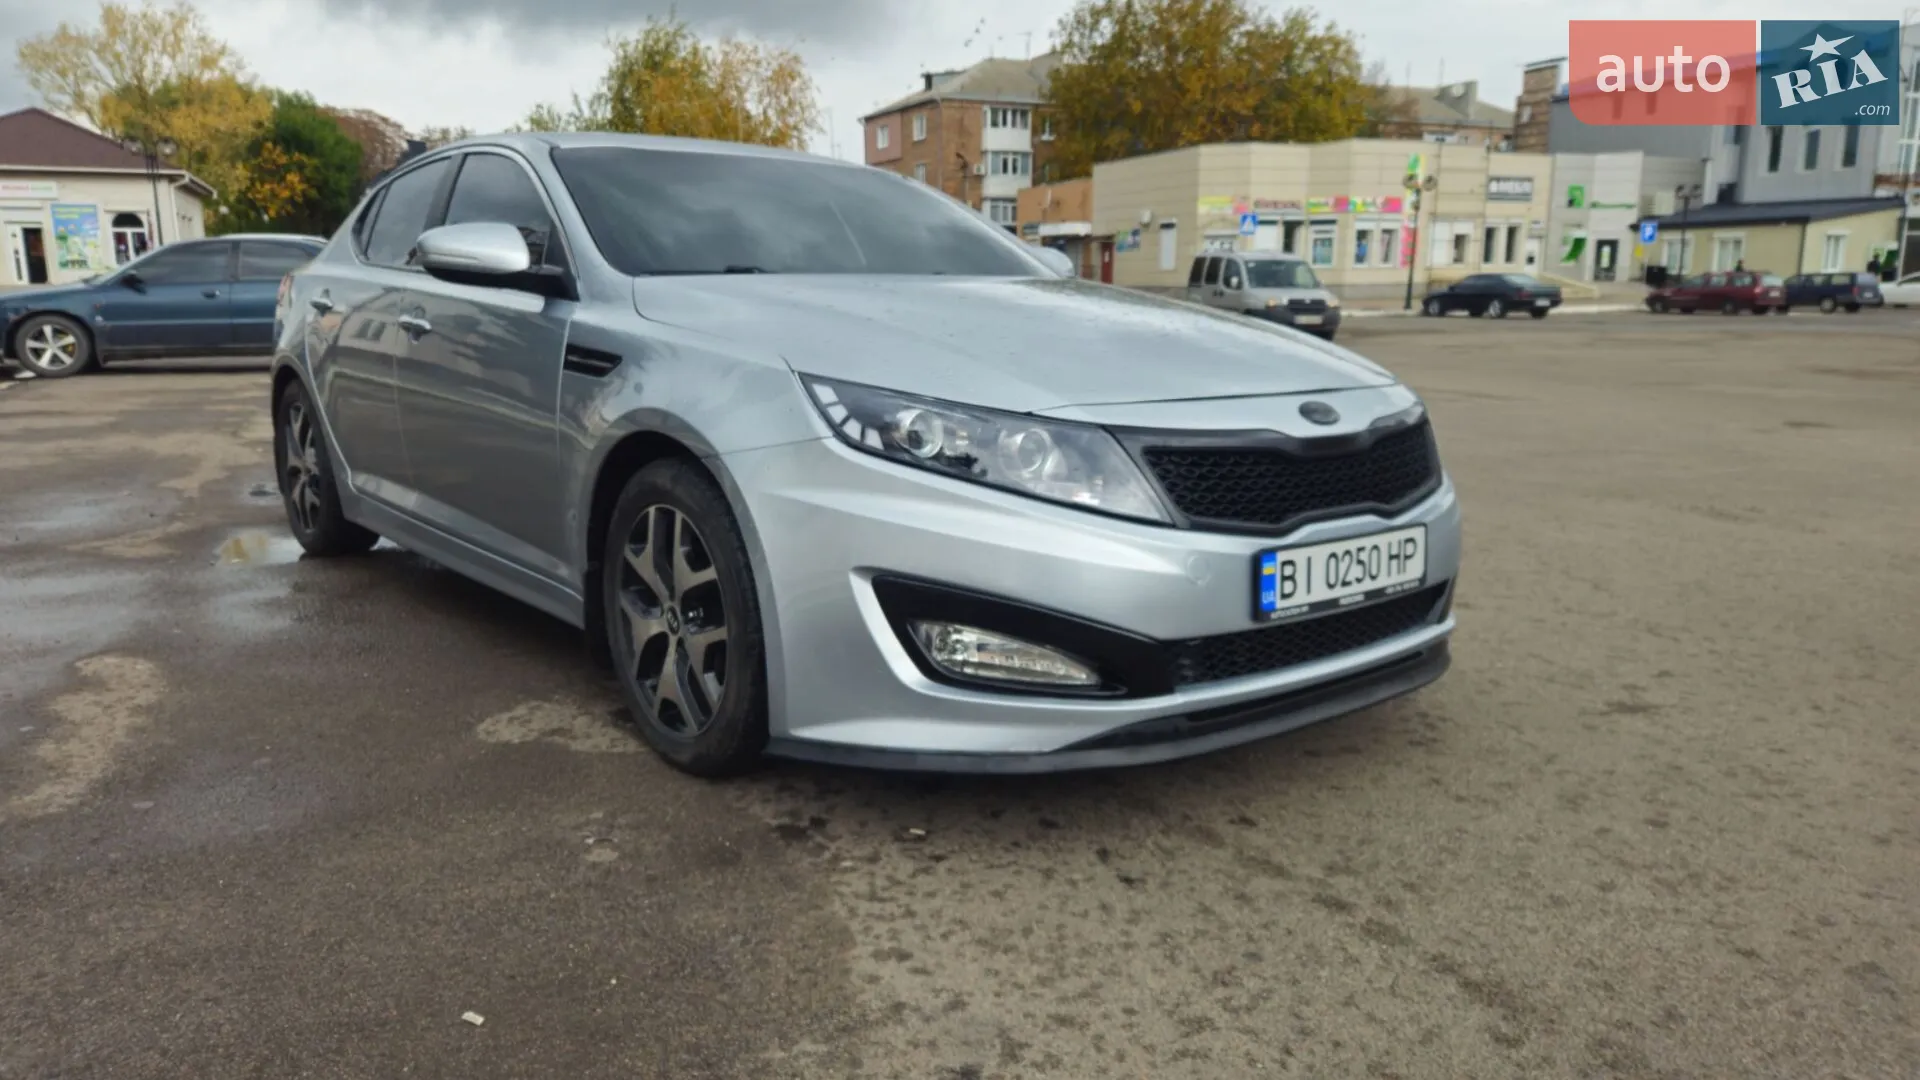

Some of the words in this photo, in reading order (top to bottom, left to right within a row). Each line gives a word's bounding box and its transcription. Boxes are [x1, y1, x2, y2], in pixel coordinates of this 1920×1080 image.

[1280, 557, 1312, 601] BI
[1326, 544, 1381, 590] 0250
[1387, 537, 1417, 577] HP
[1262, 589, 1276, 604] UA
